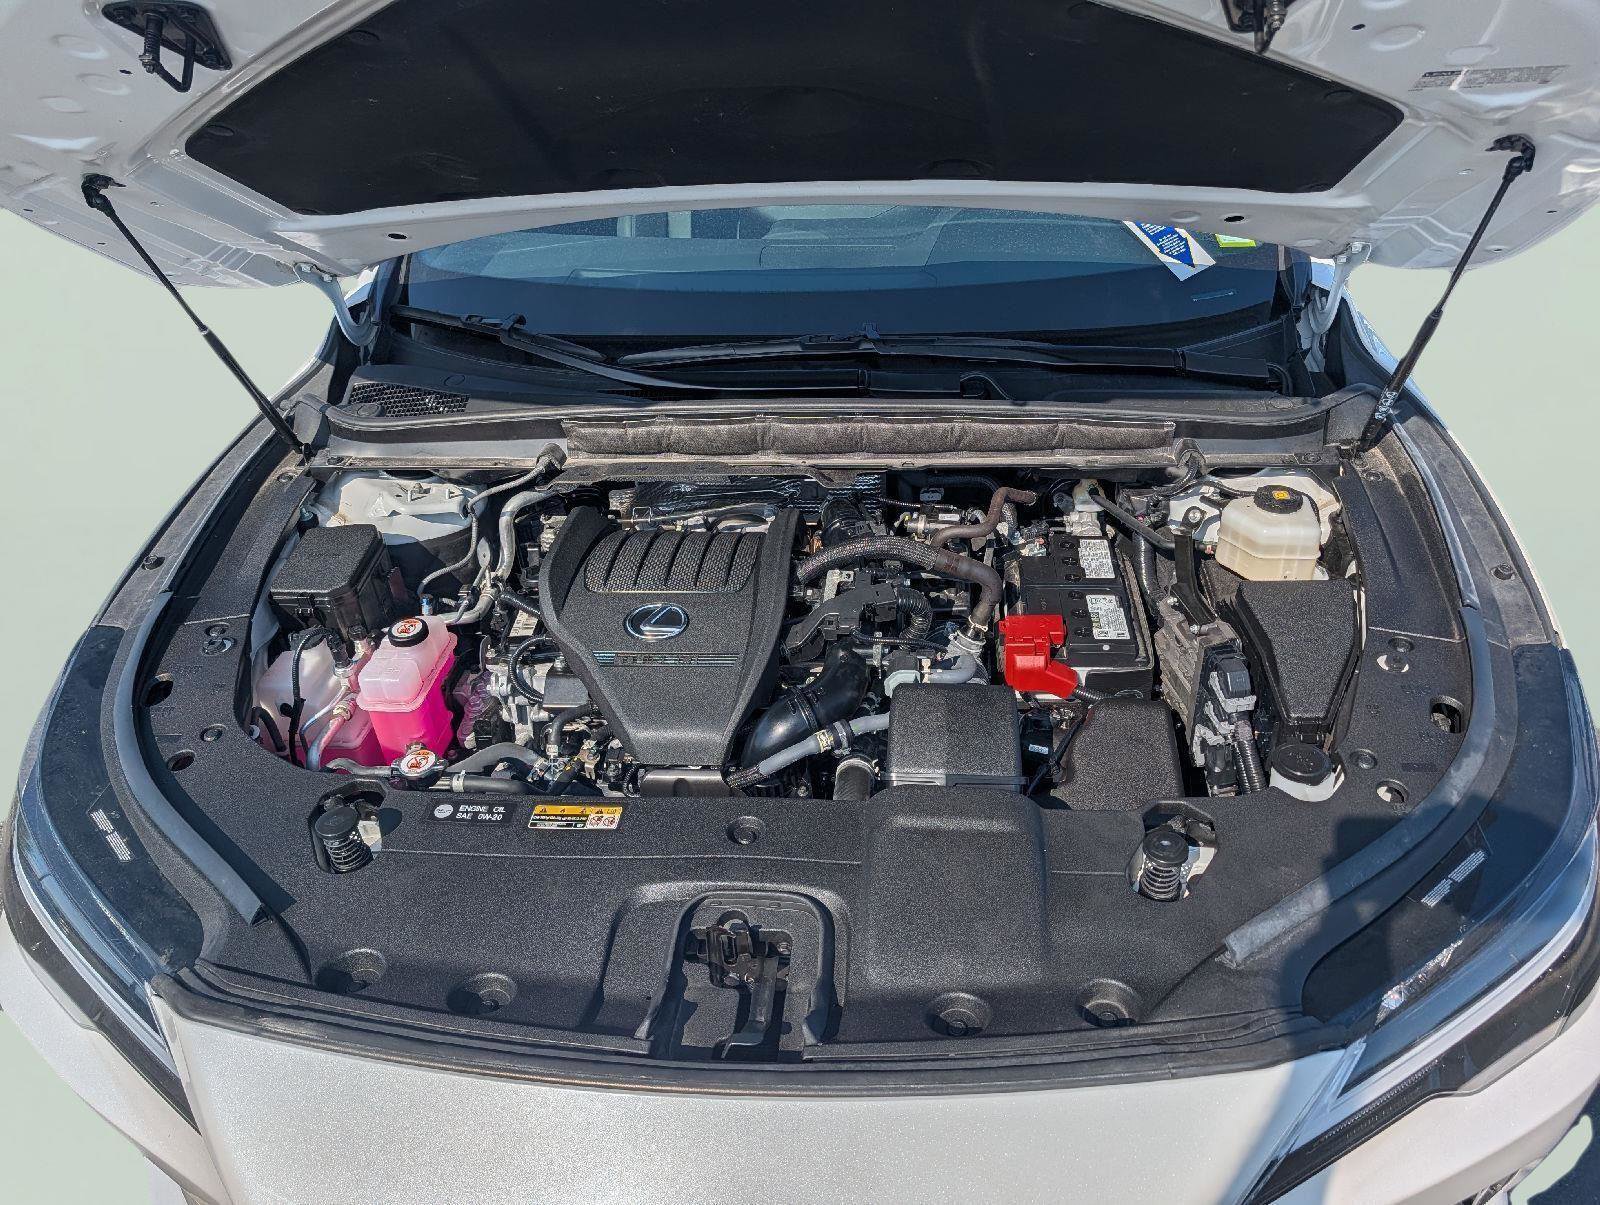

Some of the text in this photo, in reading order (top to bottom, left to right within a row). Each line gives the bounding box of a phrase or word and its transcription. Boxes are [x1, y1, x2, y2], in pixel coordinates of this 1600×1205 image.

[459, 804, 489, 812] ENGINE
[455, 812, 503, 821] SAE 0W-20
